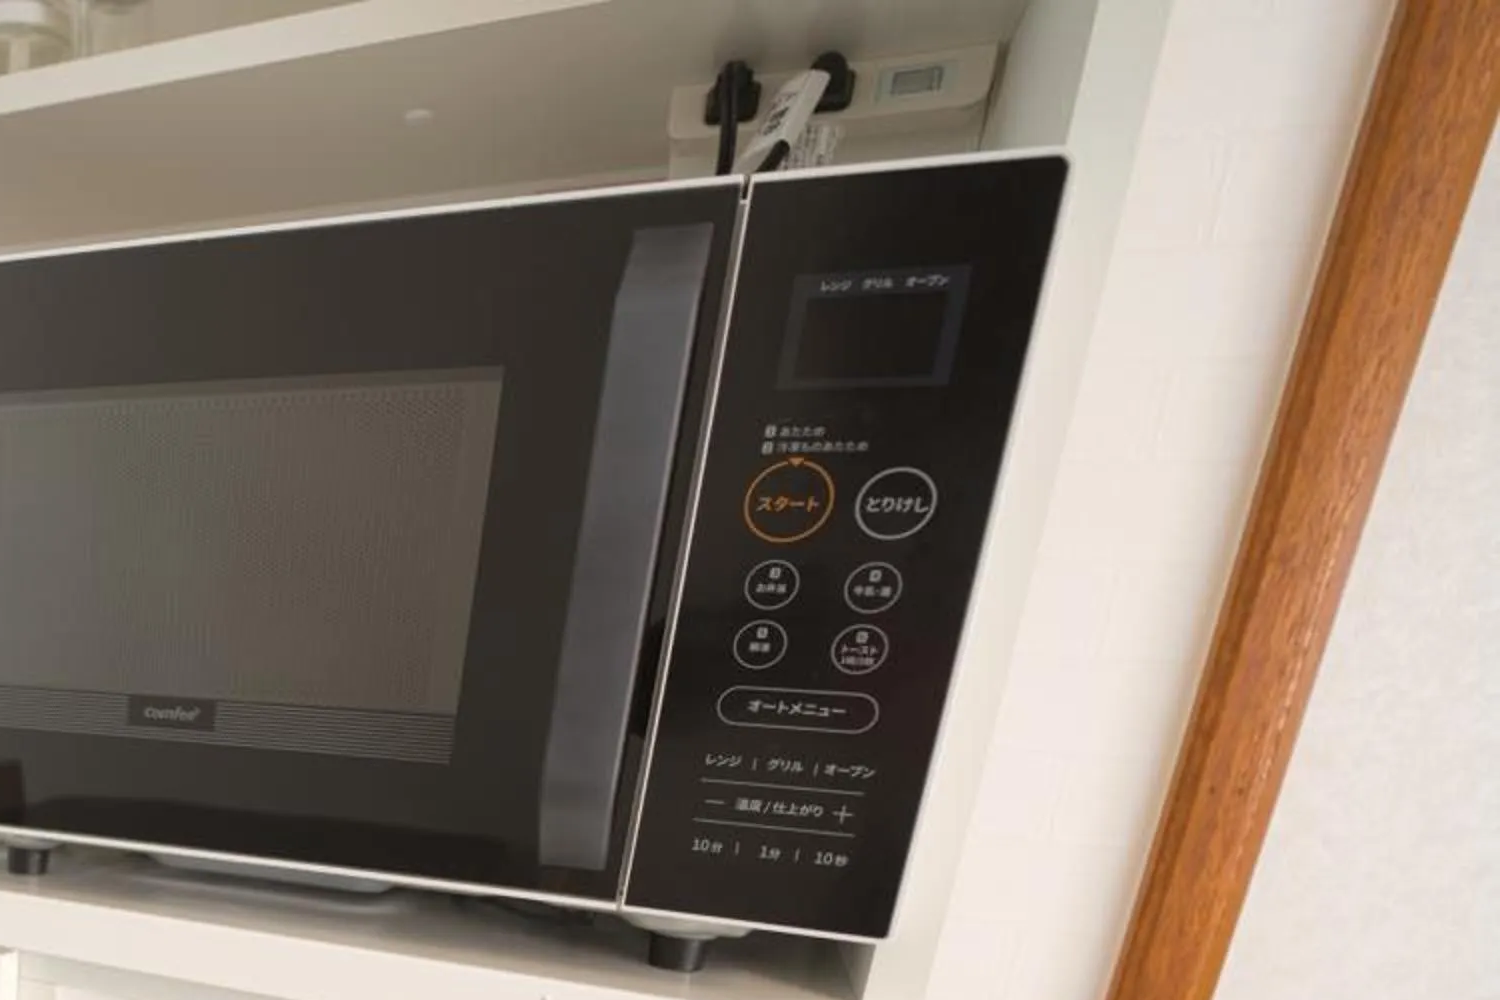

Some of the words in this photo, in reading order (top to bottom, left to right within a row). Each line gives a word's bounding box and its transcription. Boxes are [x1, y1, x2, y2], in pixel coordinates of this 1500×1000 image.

[820, 279, 852, 292] レンジ
[756, 496, 820, 512] スタート
[866, 497, 928, 513] とりけし
[747, 700, 847, 718] オートメニュー
[705, 754, 742, 767] レンジ
[766, 758, 804, 772] グリル
